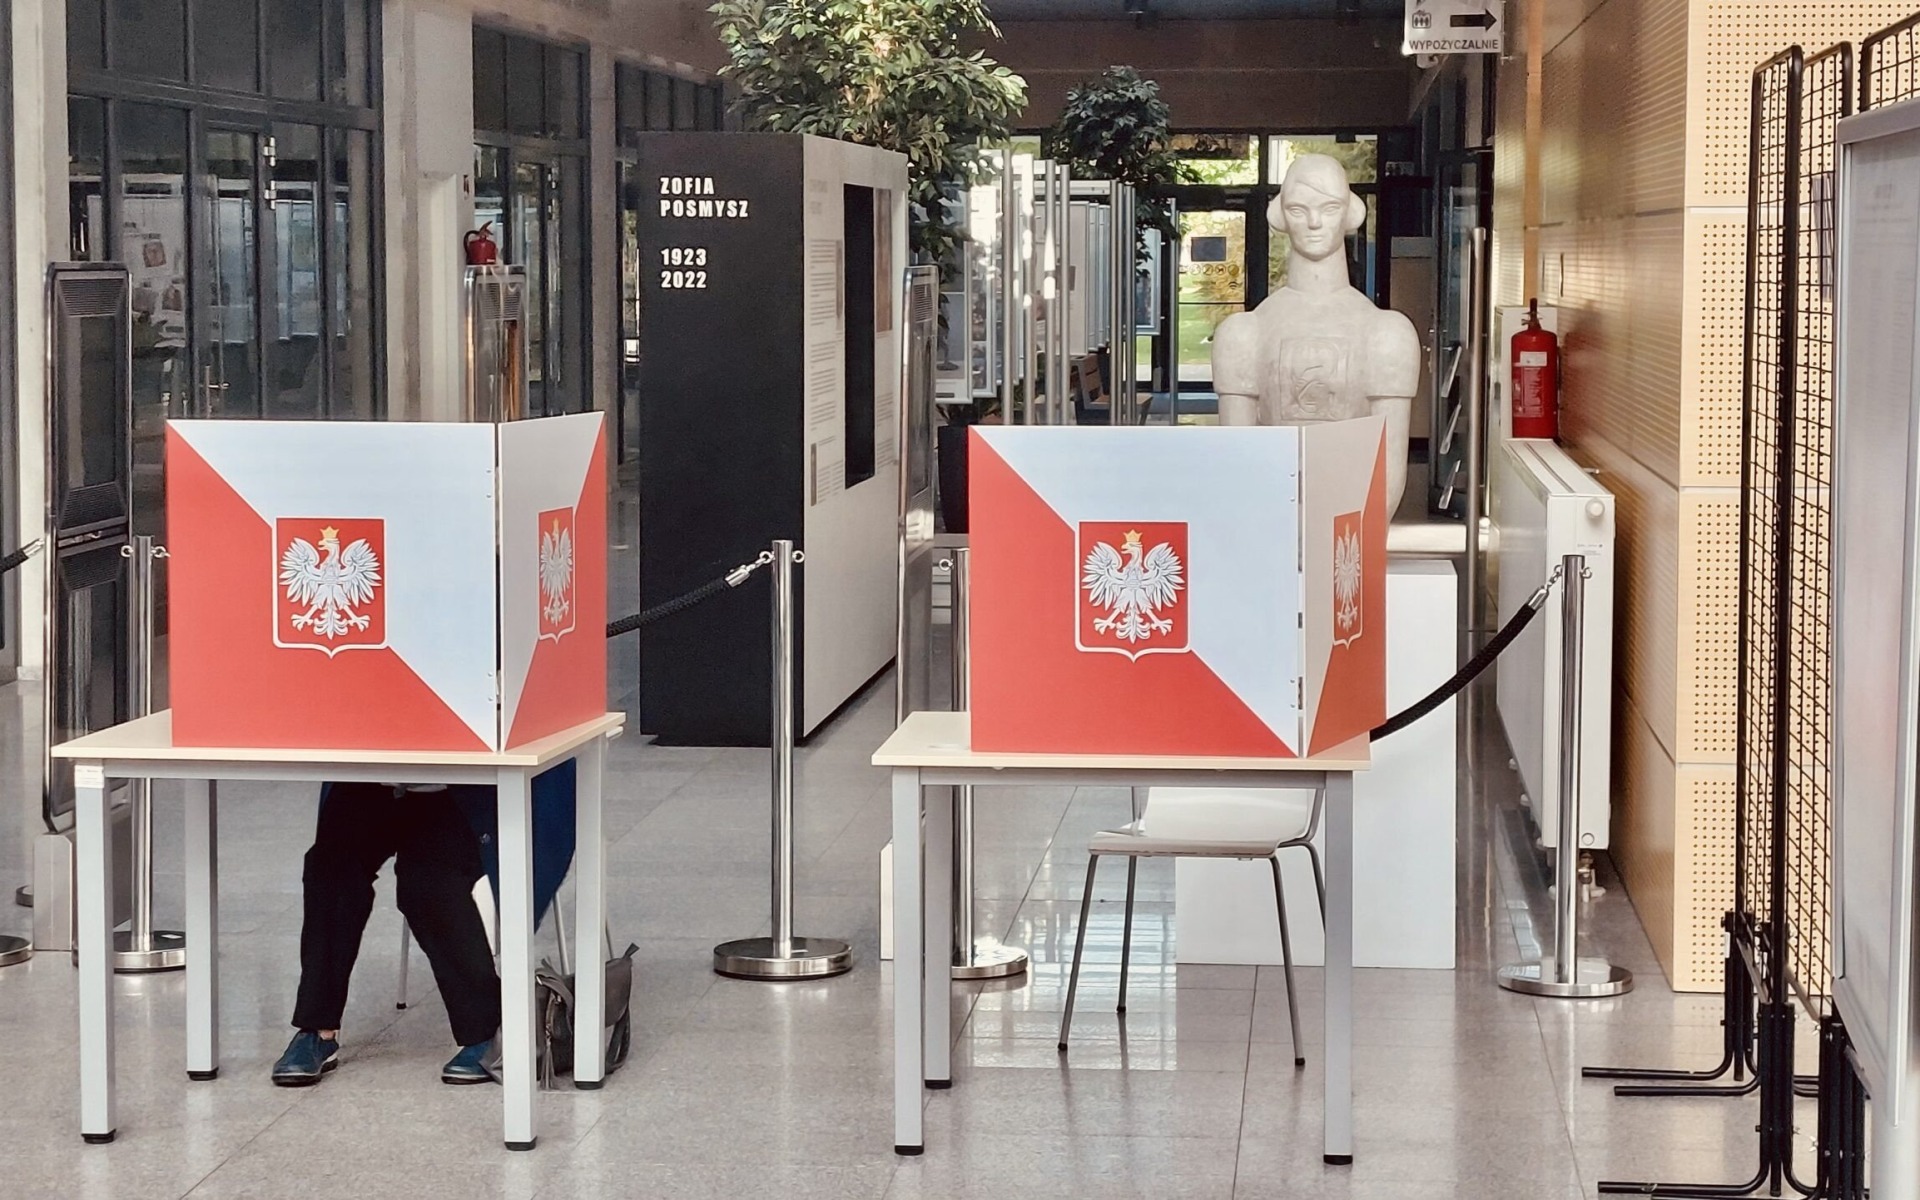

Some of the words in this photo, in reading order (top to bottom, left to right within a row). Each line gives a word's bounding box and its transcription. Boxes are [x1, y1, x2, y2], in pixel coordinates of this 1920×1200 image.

[660, 177, 715, 195] ZOFIA
[660, 200, 749, 218] POSMYSZ
[660, 248, 707, 266] 1923
[660, 270, 707, 289] 2022
